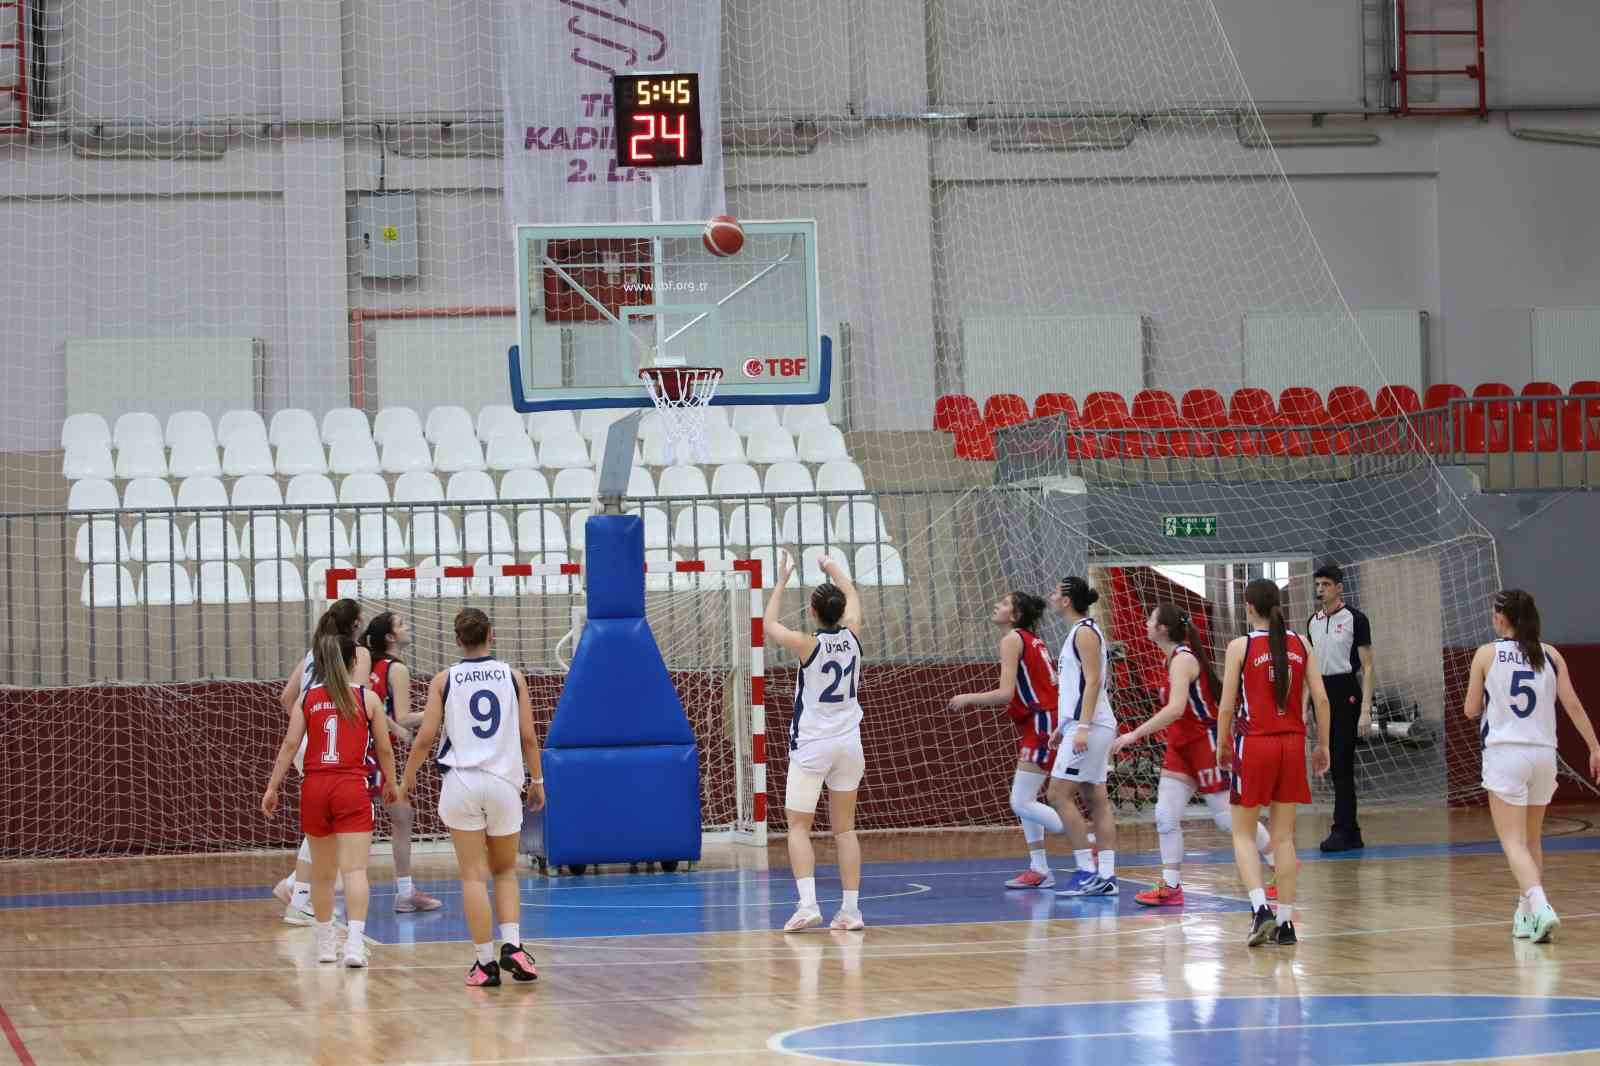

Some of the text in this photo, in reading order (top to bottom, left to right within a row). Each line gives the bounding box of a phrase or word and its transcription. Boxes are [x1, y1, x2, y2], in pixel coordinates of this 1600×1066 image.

[637, 80, 690, 105] 5:45
[630, 114, 686, 160] 24
[567, 159, 596, 183] 2.
[622, 280, 709, 293] www.bf.org.tr
[765, 358, 807, 377] TBF
[1498, 650, 1531, 666] BALK
[455, 670, 506, 687] ÇARIKÇI
[819, 656, 857, 703] 21
[1509, 671, 1537, 719] 5
[469, 689, 501, 739] 9
[321, 714, 340, 764] 1
